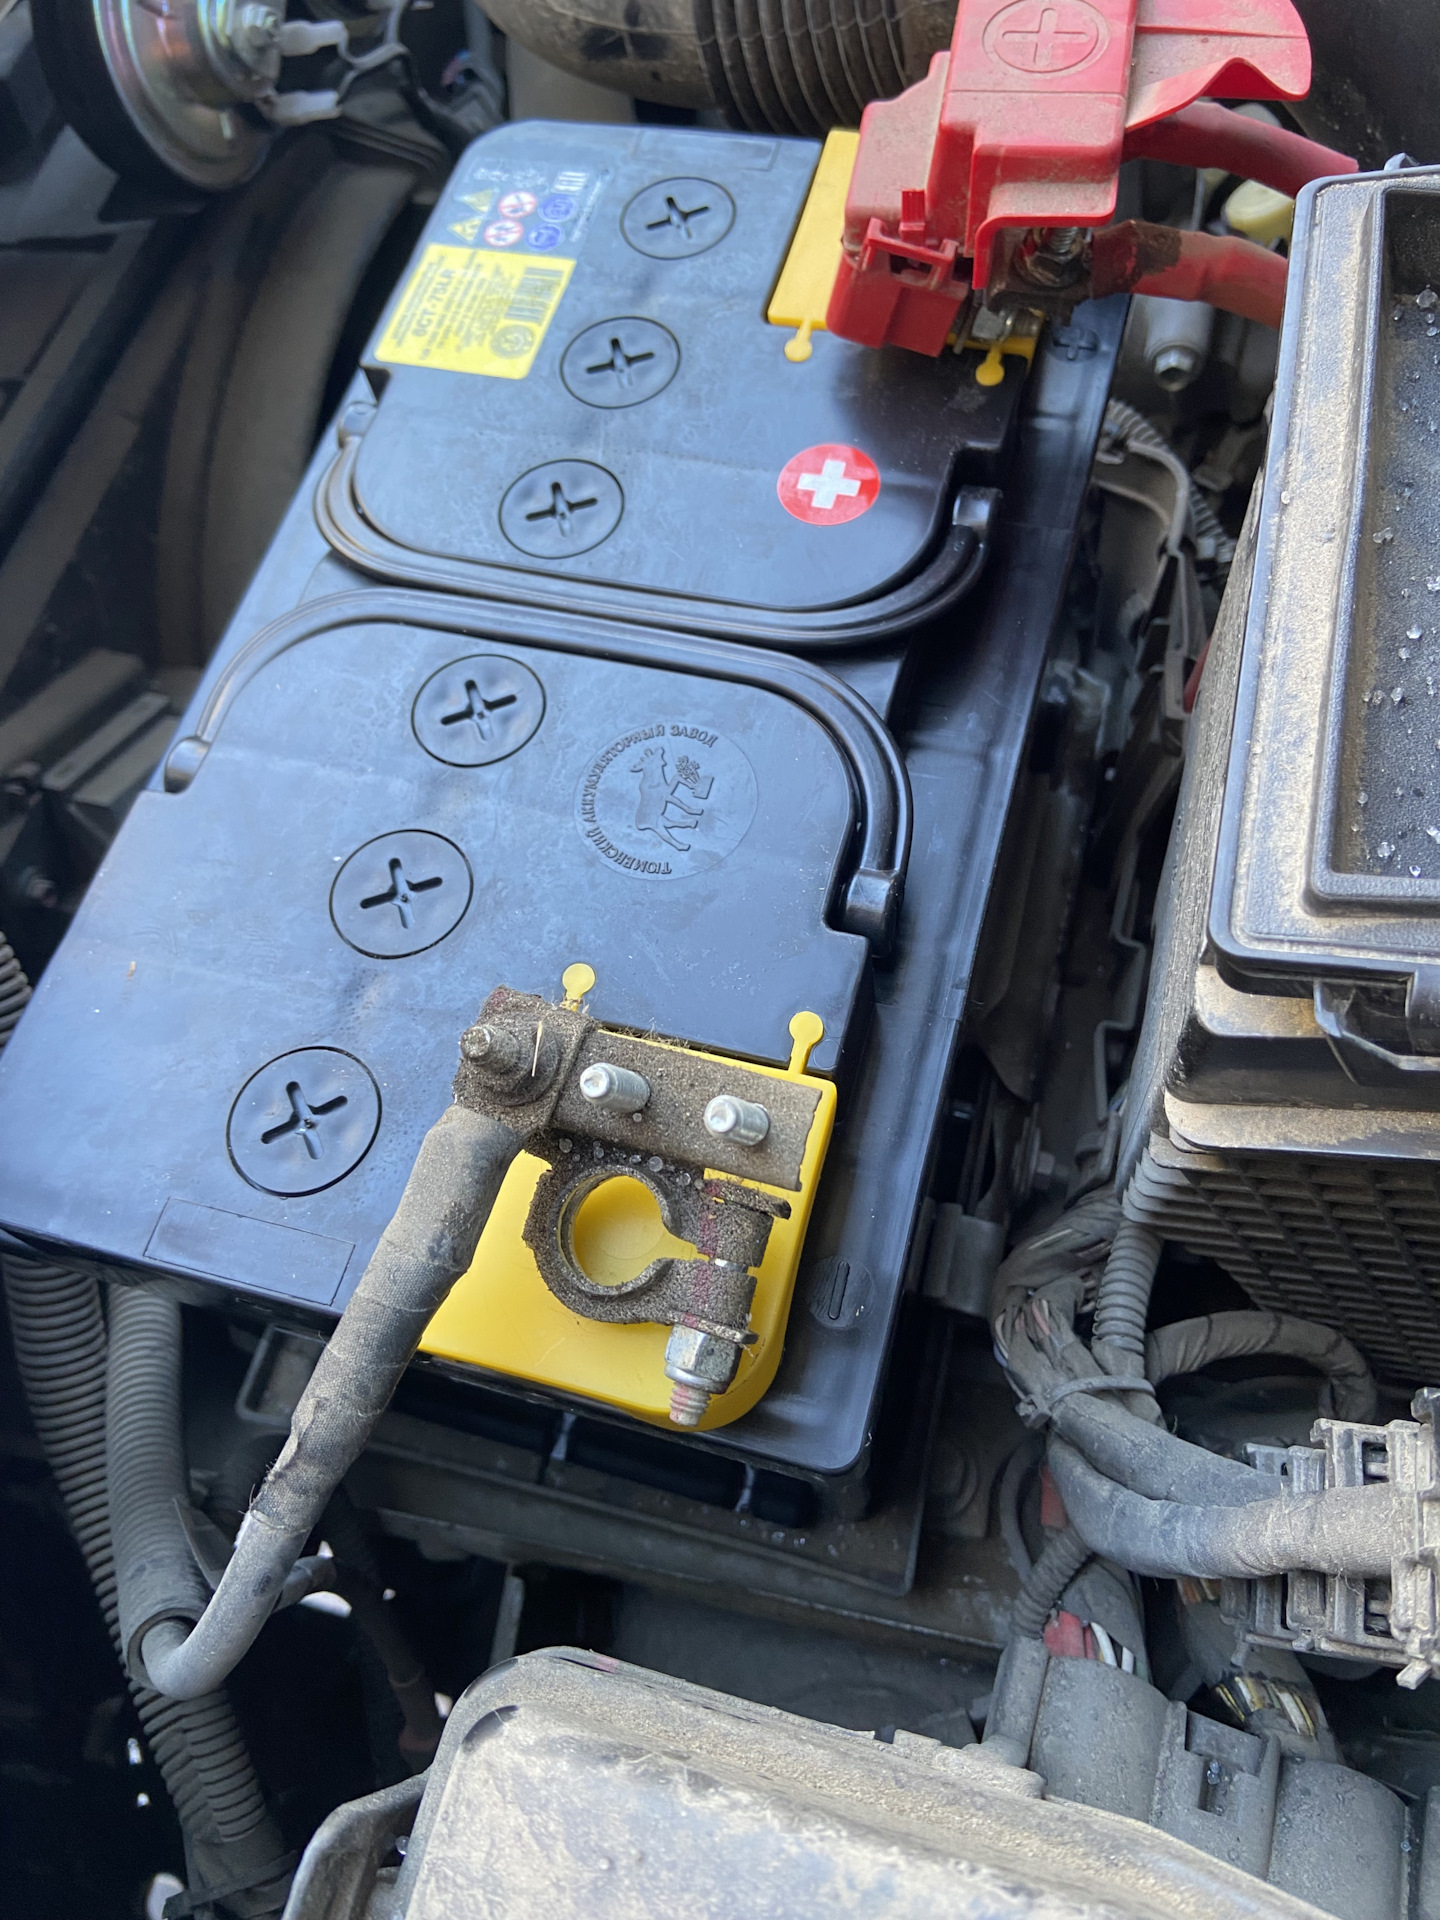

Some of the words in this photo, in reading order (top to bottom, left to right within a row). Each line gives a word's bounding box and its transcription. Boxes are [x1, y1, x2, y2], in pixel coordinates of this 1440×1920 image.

[670, 724, 718, 748] ЗАВОД
[582, 724, 665, 823] АККУМУЛЯТОРНЫЙ
[585, 826, 673, 874] ТЮМЕНСКИЙ
